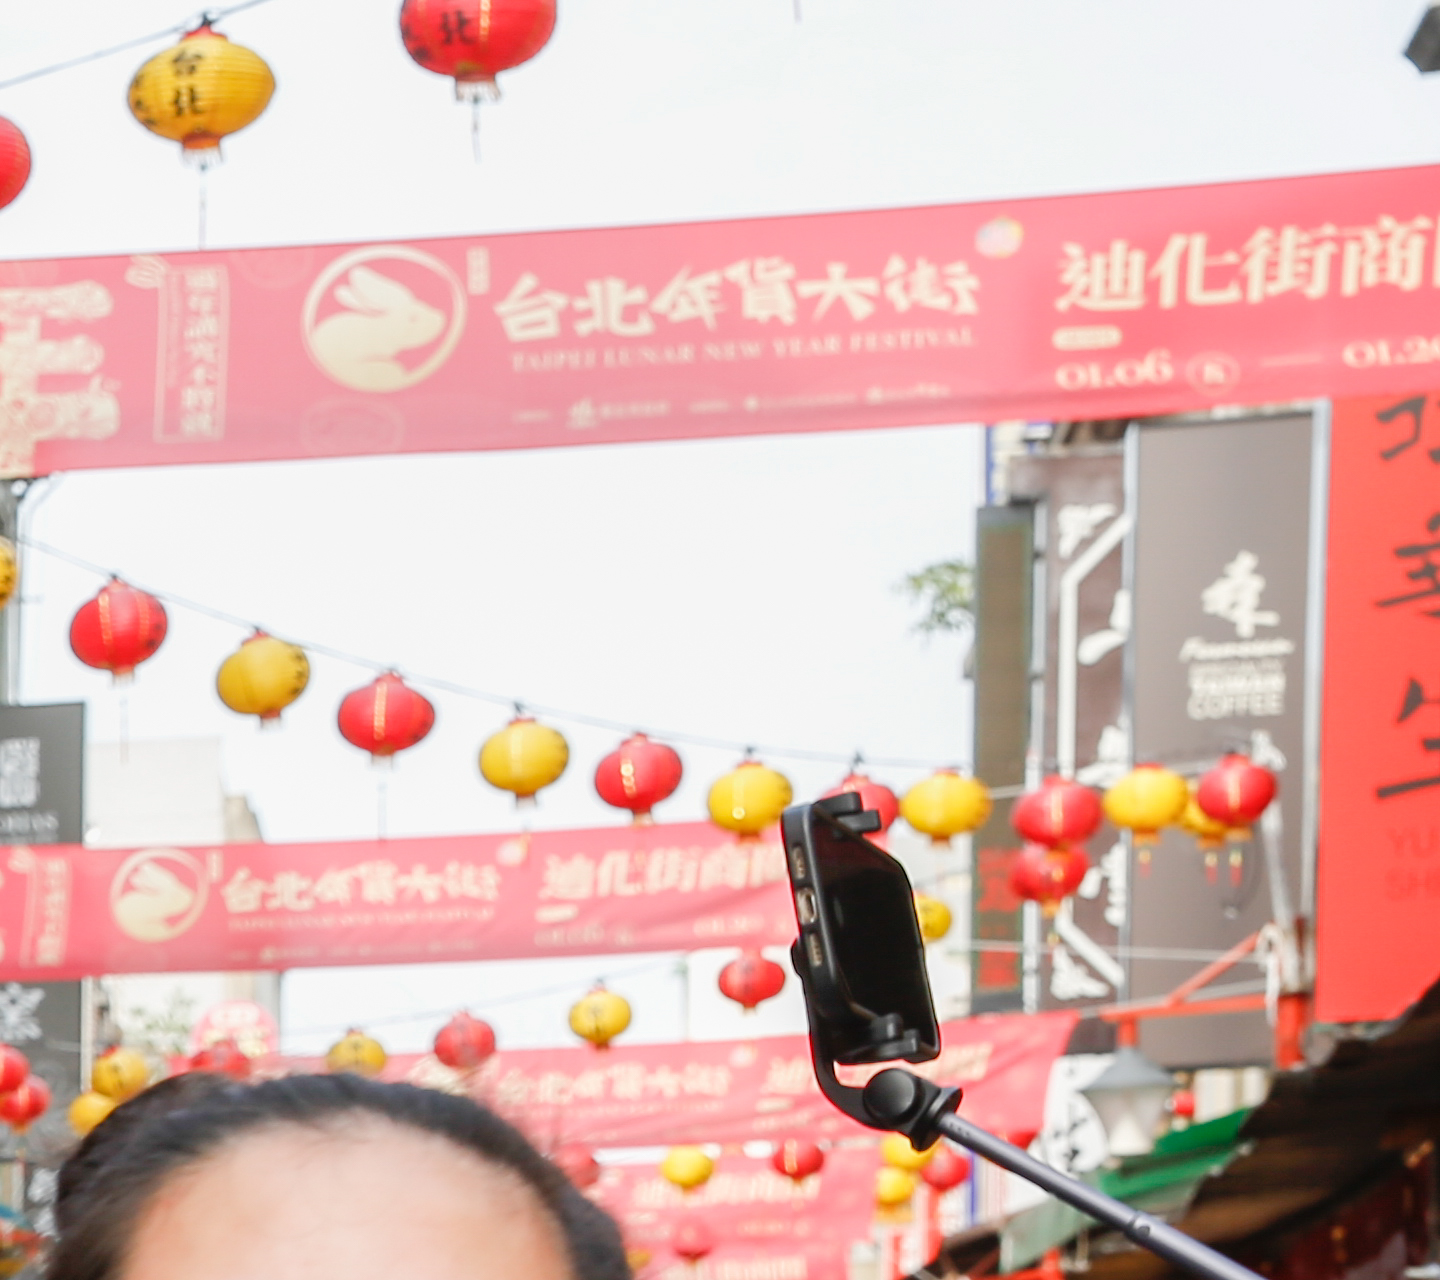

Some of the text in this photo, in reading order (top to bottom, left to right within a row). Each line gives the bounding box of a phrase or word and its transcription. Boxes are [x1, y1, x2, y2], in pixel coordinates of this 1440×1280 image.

[494, 254, 979, 342] 台北年貨大街
[1055, 213, 1440, 313] 迪化街商
[511, 326, 975, 371] TAIPEI LUNAR NEW YEAR FESTIVAL
